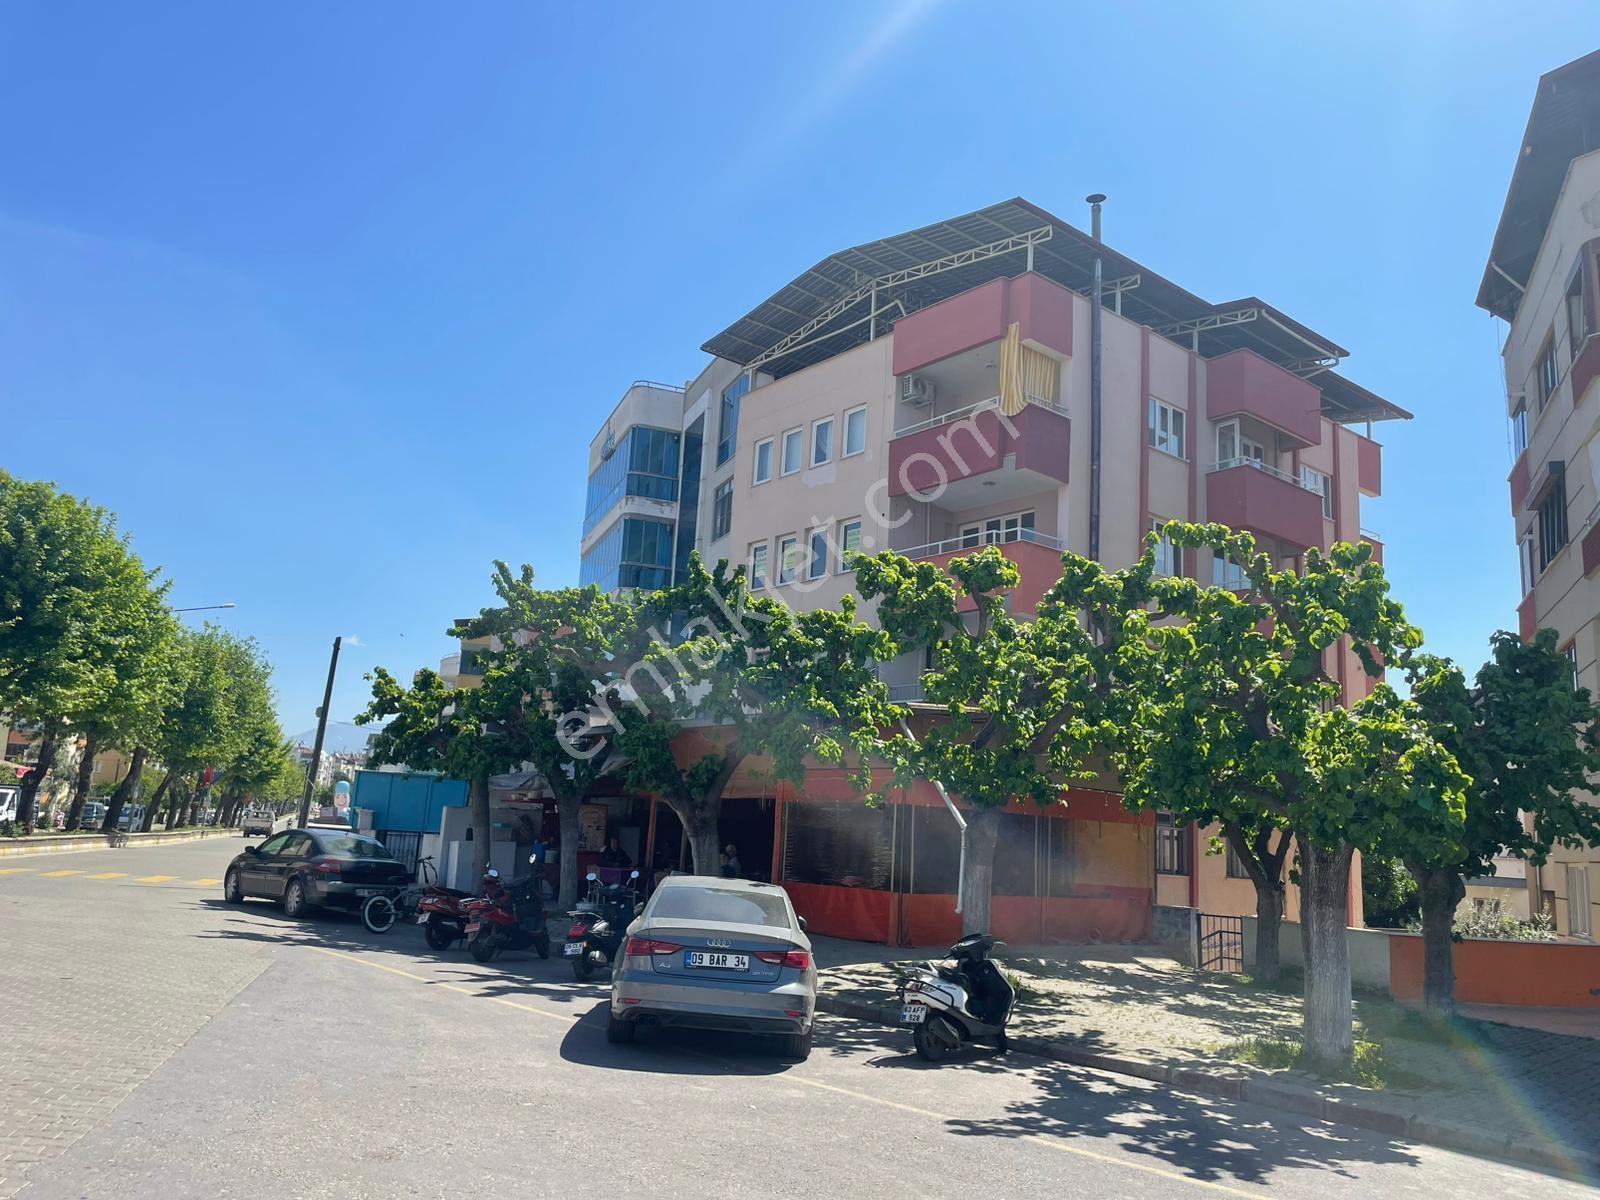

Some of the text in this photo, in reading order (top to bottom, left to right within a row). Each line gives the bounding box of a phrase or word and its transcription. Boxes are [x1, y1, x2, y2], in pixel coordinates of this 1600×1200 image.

[691, 953, 746, 968] 09 BAR 34
